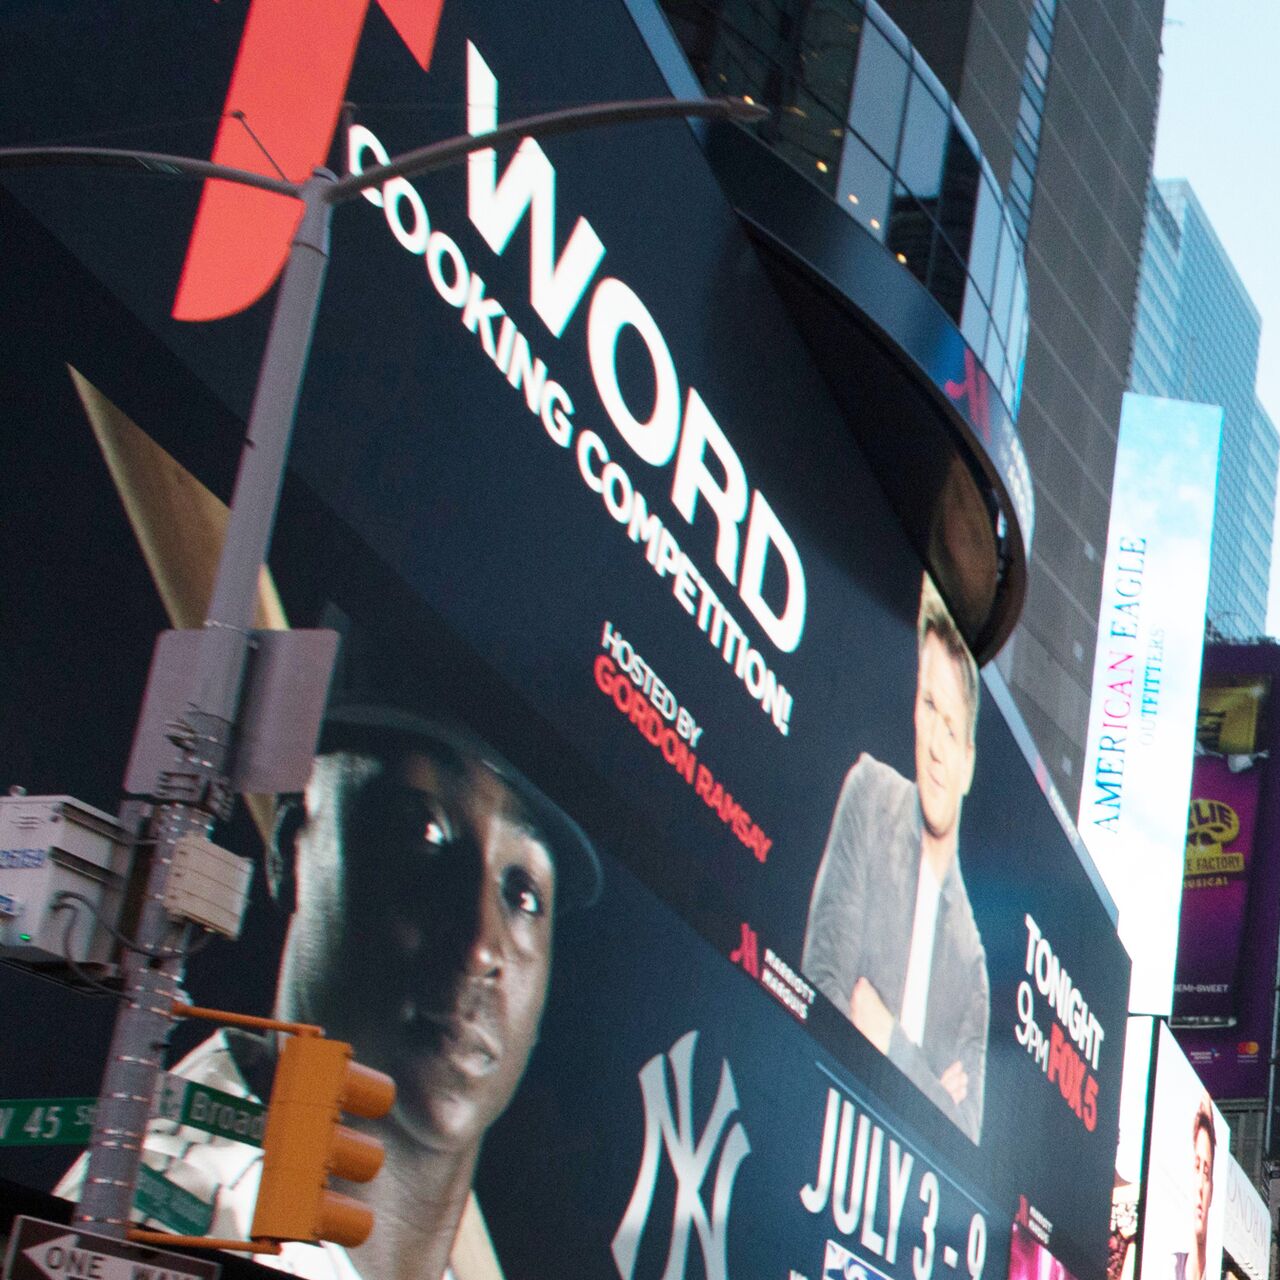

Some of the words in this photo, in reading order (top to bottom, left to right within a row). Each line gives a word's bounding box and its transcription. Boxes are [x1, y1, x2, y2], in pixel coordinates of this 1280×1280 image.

[467, 37, 807, 654] WORD
[348, 123, 577, 449] COOKING
[576, 429, 795, 737] COMPETITION!
[1110, 535, 1147, 640] EAGLE
[593, 654, 697, 784] GORDON
[695, 763, 773, 864] RAMSAY
[602, 620, 678, 721] HOSTED
[676, 706, 704, 748] BY
[1090, 644, 1136, 833] AMERICAN
[1025, 912, 1104, 1071] TONIGHT
[22, 1106, 64, 1139] 45
[799, 1087, 914, 1265] JULY
[44, 1245, 107, 1279] ONE
